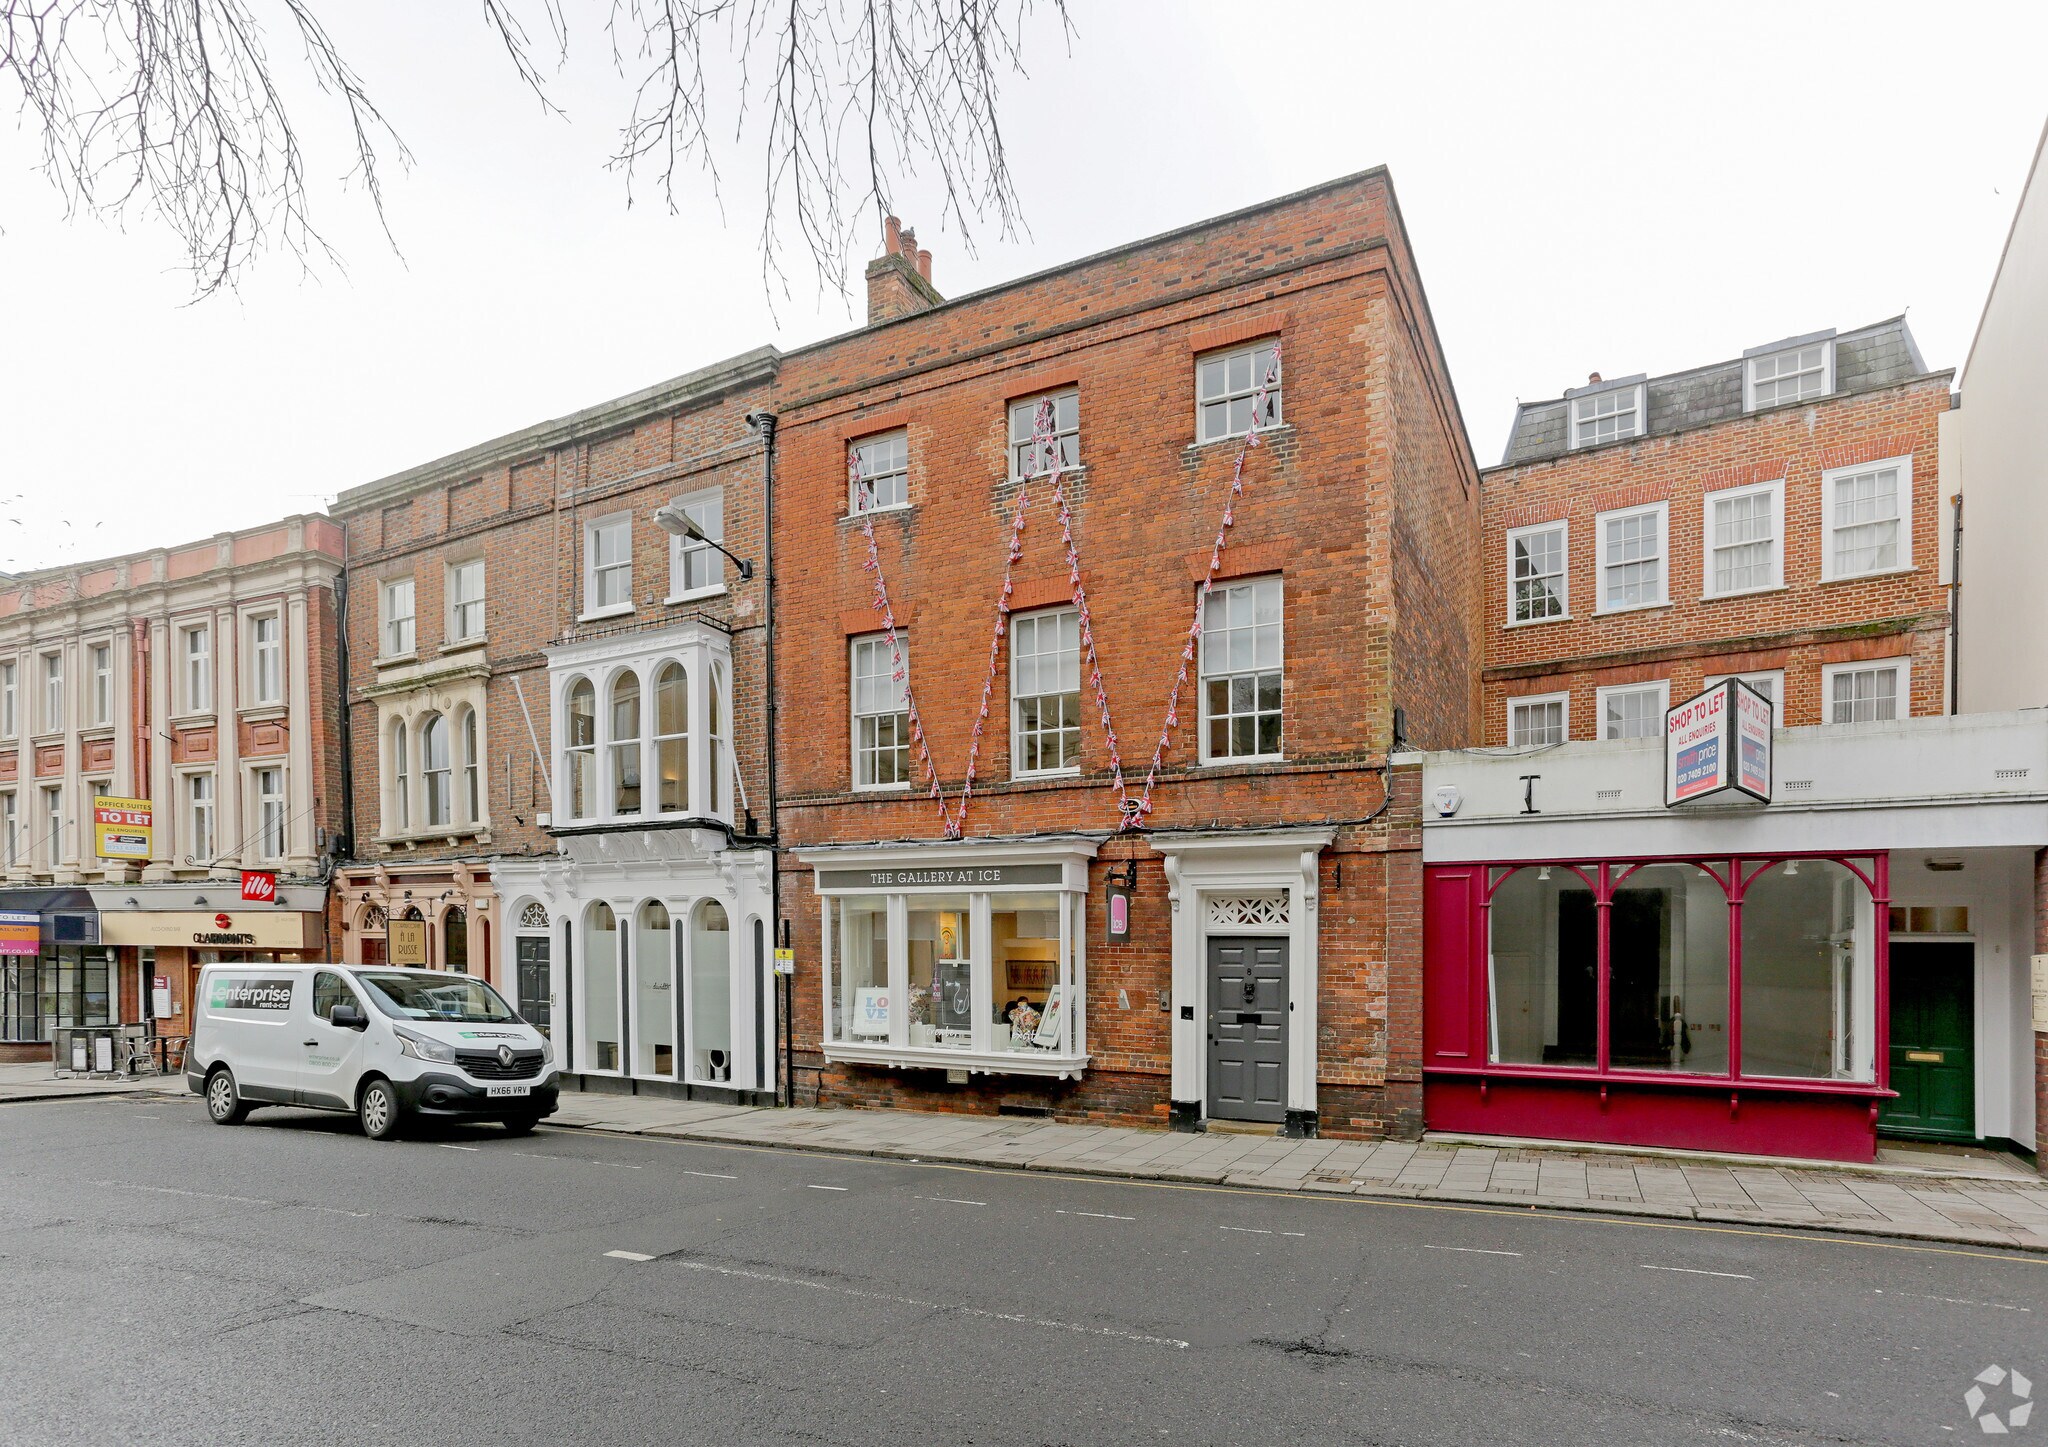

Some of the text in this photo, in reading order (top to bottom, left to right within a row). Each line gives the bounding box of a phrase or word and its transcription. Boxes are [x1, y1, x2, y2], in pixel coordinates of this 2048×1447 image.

[1670, 692, 1724, 733] SHOP TO LET
[1738, 690, 1769, 726] SHOP TO LET
[1678, 721, 1716, 746] ALL ENQUIRIES
[1698, 744, 1716, 766] price
[1677, 762, 1717, 784] 020 7409 2100
[98, 800, 152, 810] OFFICE SUITES
[100, 812, 150, 825] TO LET
[870, 870, 1000, 884] THE GALLERY AT ICE
[244, 876, 274, 900] illy
[1113, 916, 1123, 929] ice
[407, 932, 415, 942] LA
[398, 944, 418, 955] RUSSE
[1246, 968, 1252, 976] 8
[212, 984, 290, 1005] enterprise
[491, 1086, 527, 1094] HX66 VRV
